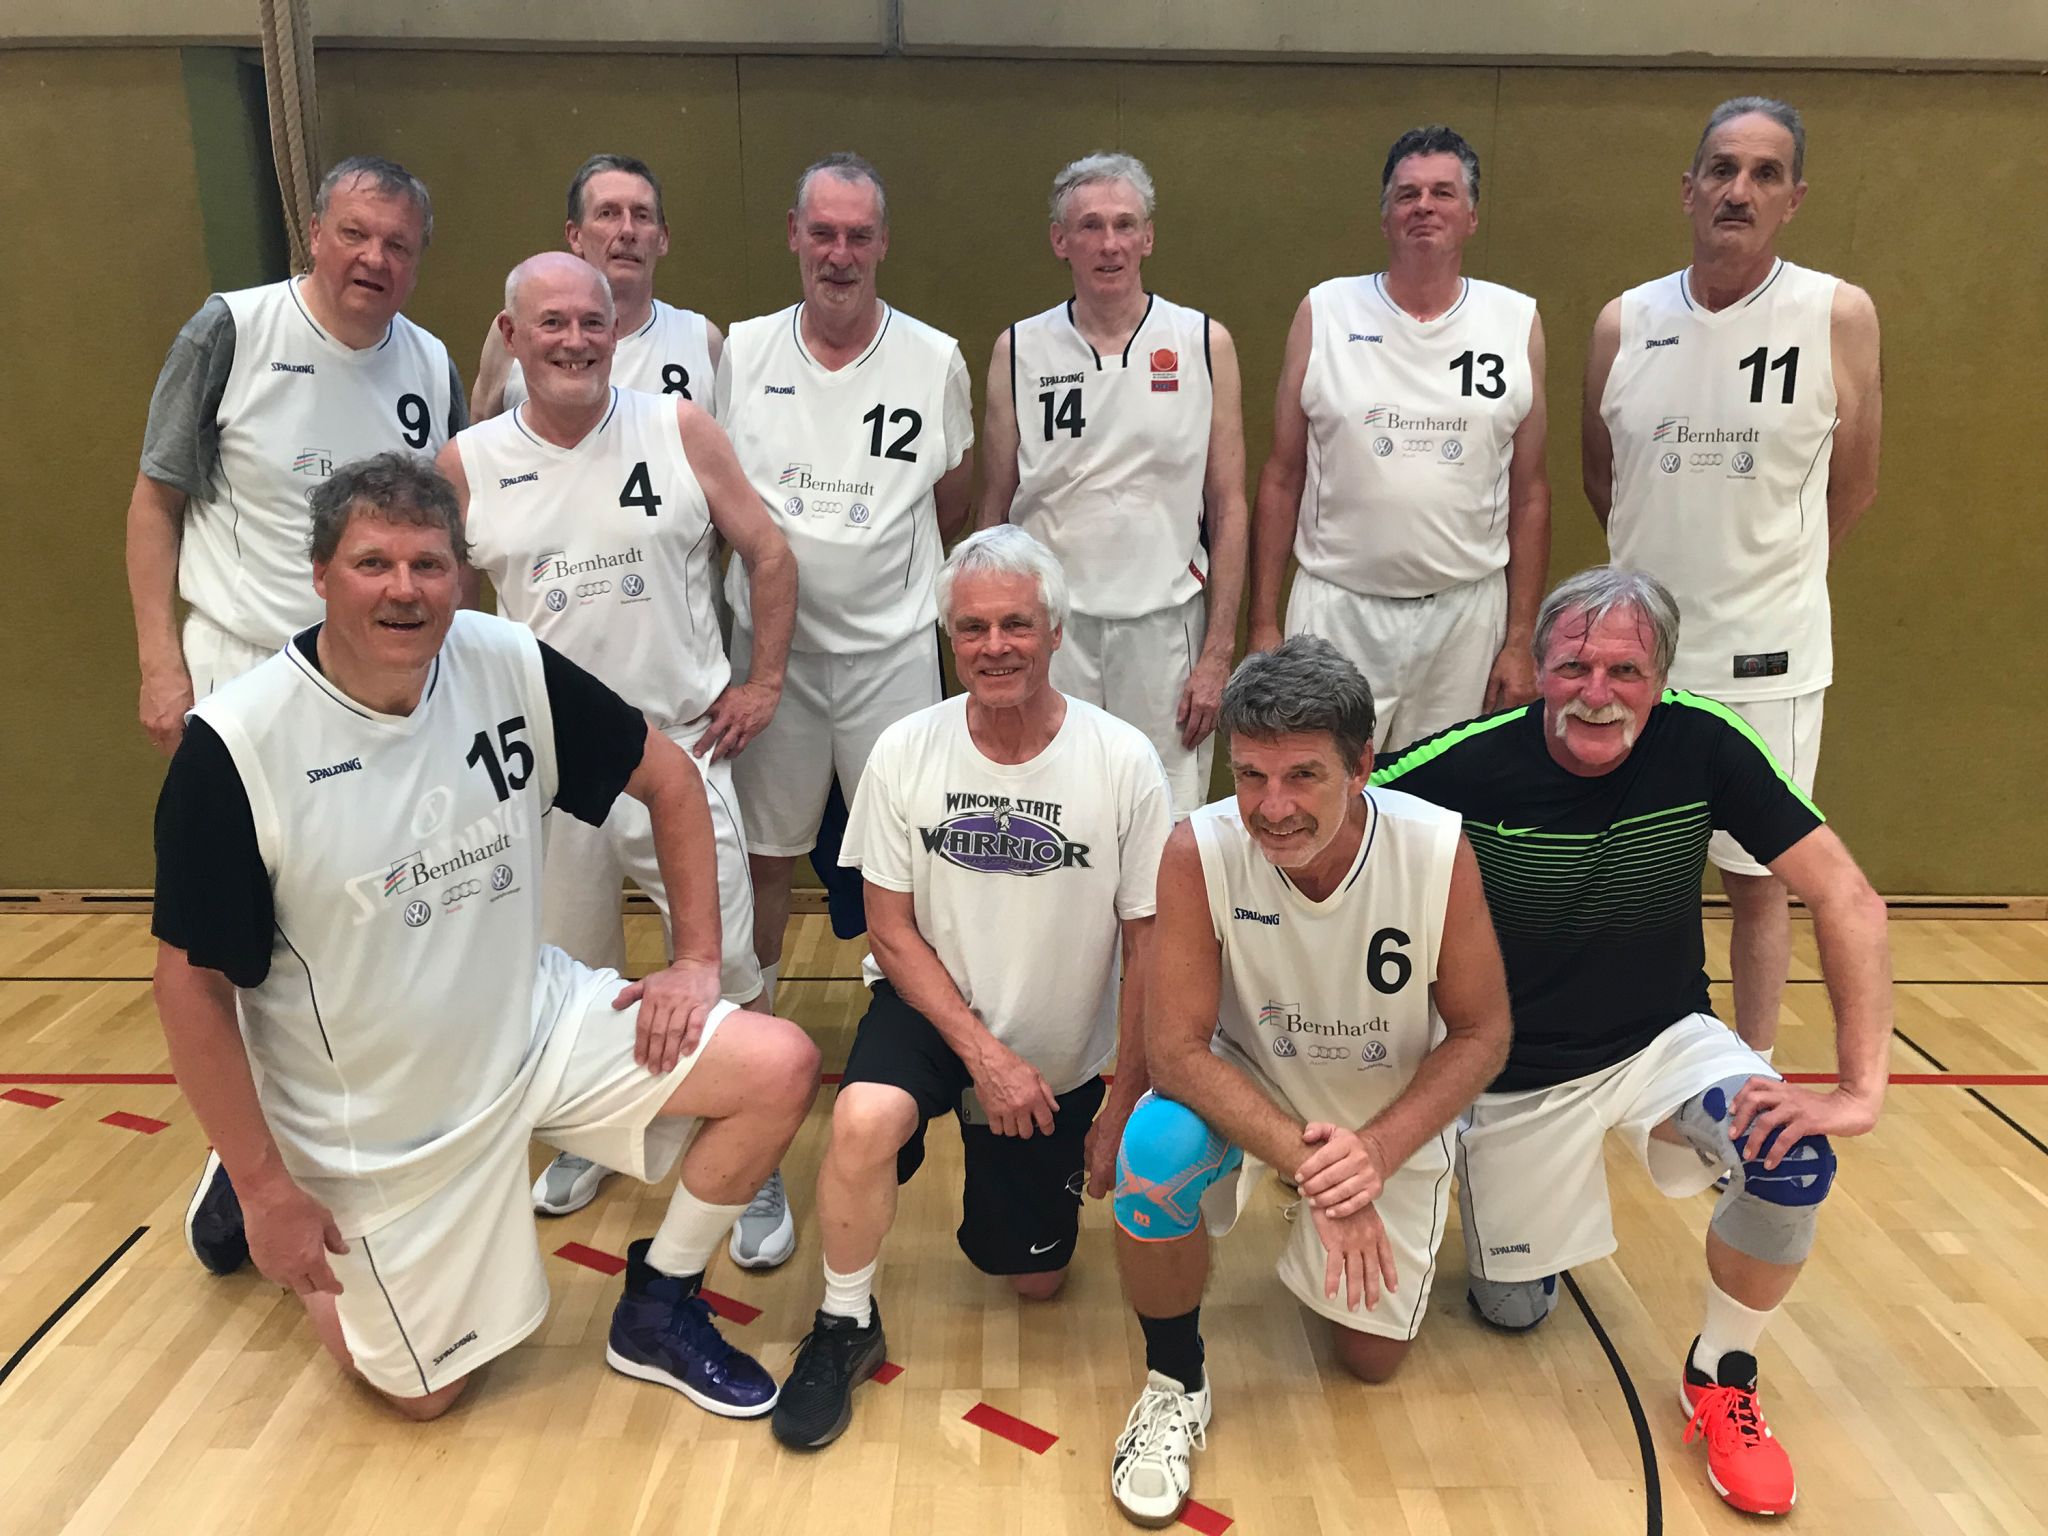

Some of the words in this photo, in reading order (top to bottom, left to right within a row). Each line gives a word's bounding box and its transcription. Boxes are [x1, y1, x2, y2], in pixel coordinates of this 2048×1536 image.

[271, 362, 315, 375] SPALDING
[661, 363, 693, 401] 8
[1039, 372, 1084, 388] SPALDING
[1449, 350, 1507, 400] 13
[1738, 346, 1800, 405] 11
[396, 393, 431, 449] 9
[1038, 388, 1086, 442] 14
[1387, 412, 1469, 433] Bernhardt
[862, 402, 923, 464] 12
[1676, 425, 1760, 444] Bernhardt
[499, 471, 539, 489] SPALDING
[618, 461, 663, 517] 4
[799, 472, 875, 497] Bernhardt
[554, 547, 644, 578] Bernhardt
[306, 757, 363, 784] SPALDING
[465, 715, 535, 803] 15
[946, 792, 1011, 815] WINONA
[1013, 798, 1063, 827] STATE
[411, 834, 512, 887] Bernhardt
[917, 826, 1094, 869] WARRIOR
[1234, 907, 1280, 926] SPALDING
[1366, 926, 1412, 995] 6
[1286, 1013, 1391, 1038] Bernhardt
[1489, 1243, 1531, 1257] SPALDING
